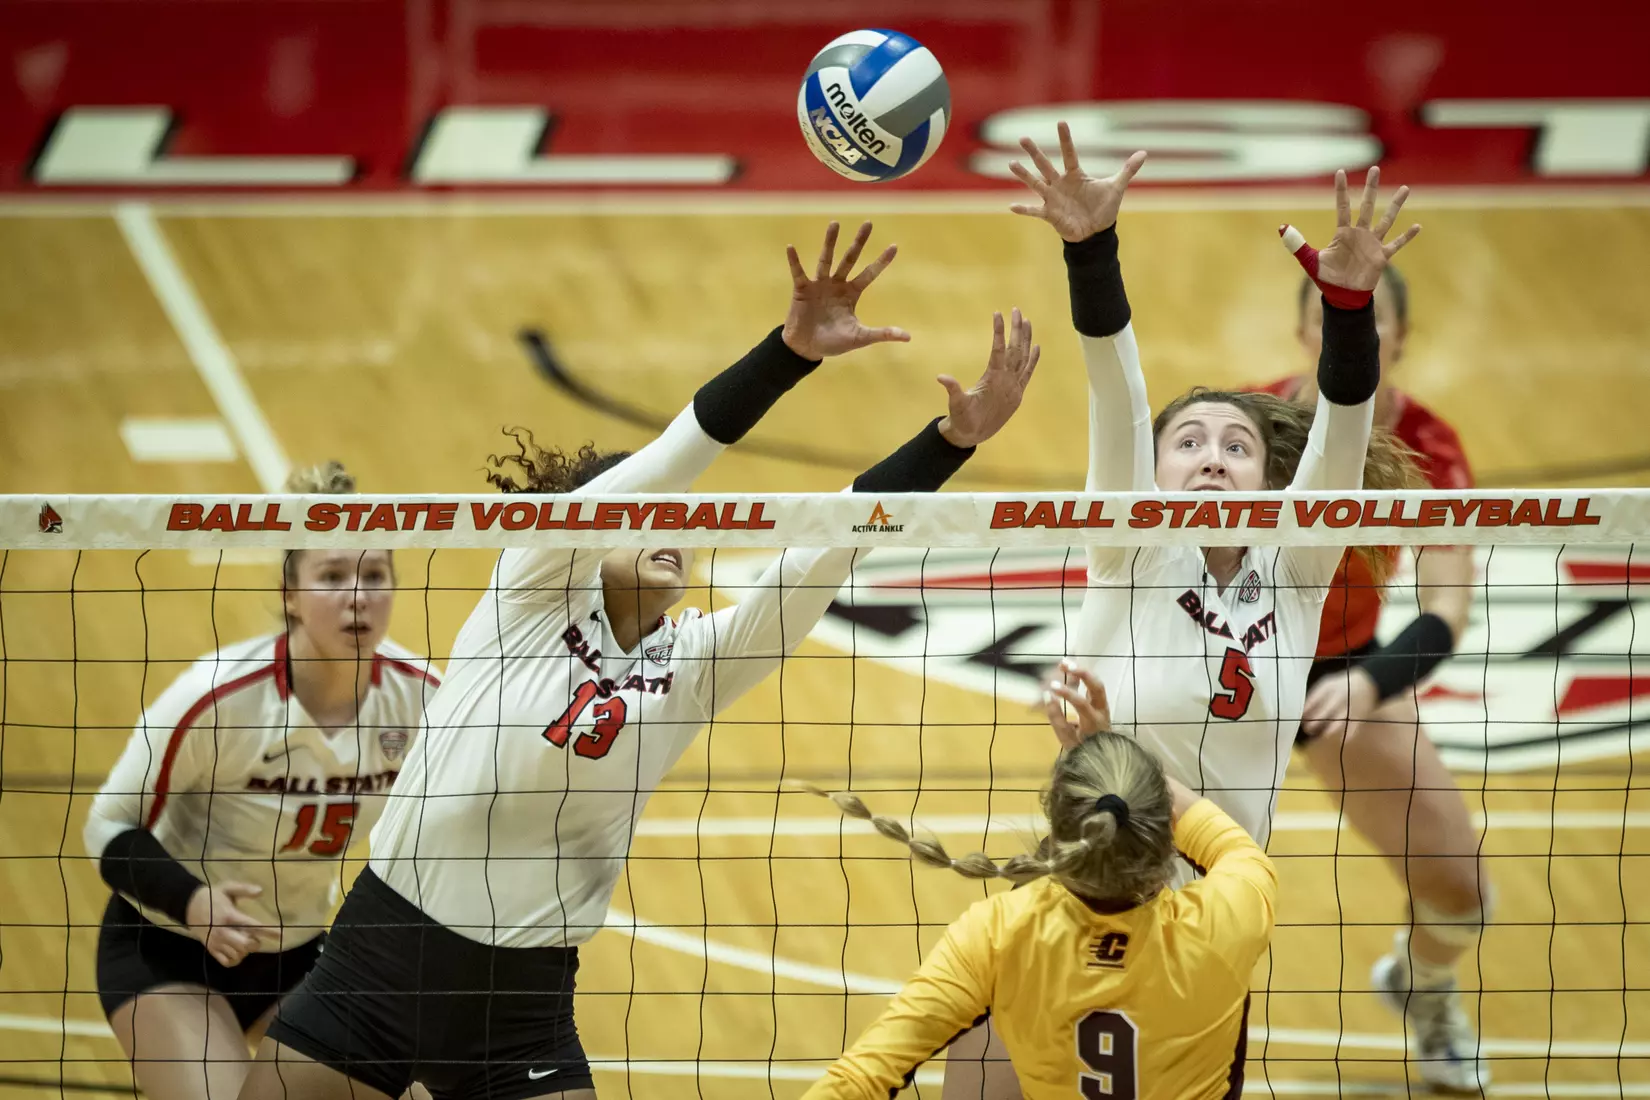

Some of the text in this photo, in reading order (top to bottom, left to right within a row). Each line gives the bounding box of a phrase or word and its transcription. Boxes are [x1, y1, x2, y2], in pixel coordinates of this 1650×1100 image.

[809, 106, 863, 166] NCAA
[826, 83, 886, 155] molten
[166, 502, 777, 532] BALL STATE VOLLEYBALL
[852, 525, 904, 533] ACTIVE ANKLE
[989, 498, 1601, 529] BALL STATE VOLLEYBALL
[562, 624, 602, 676] BAL
[1209, 646, 1256, 721] 5
[541, 678, 628, 760] 13
[278, 802, 361, 857] 15
[1075, 1008, 1139, 1100] 9
